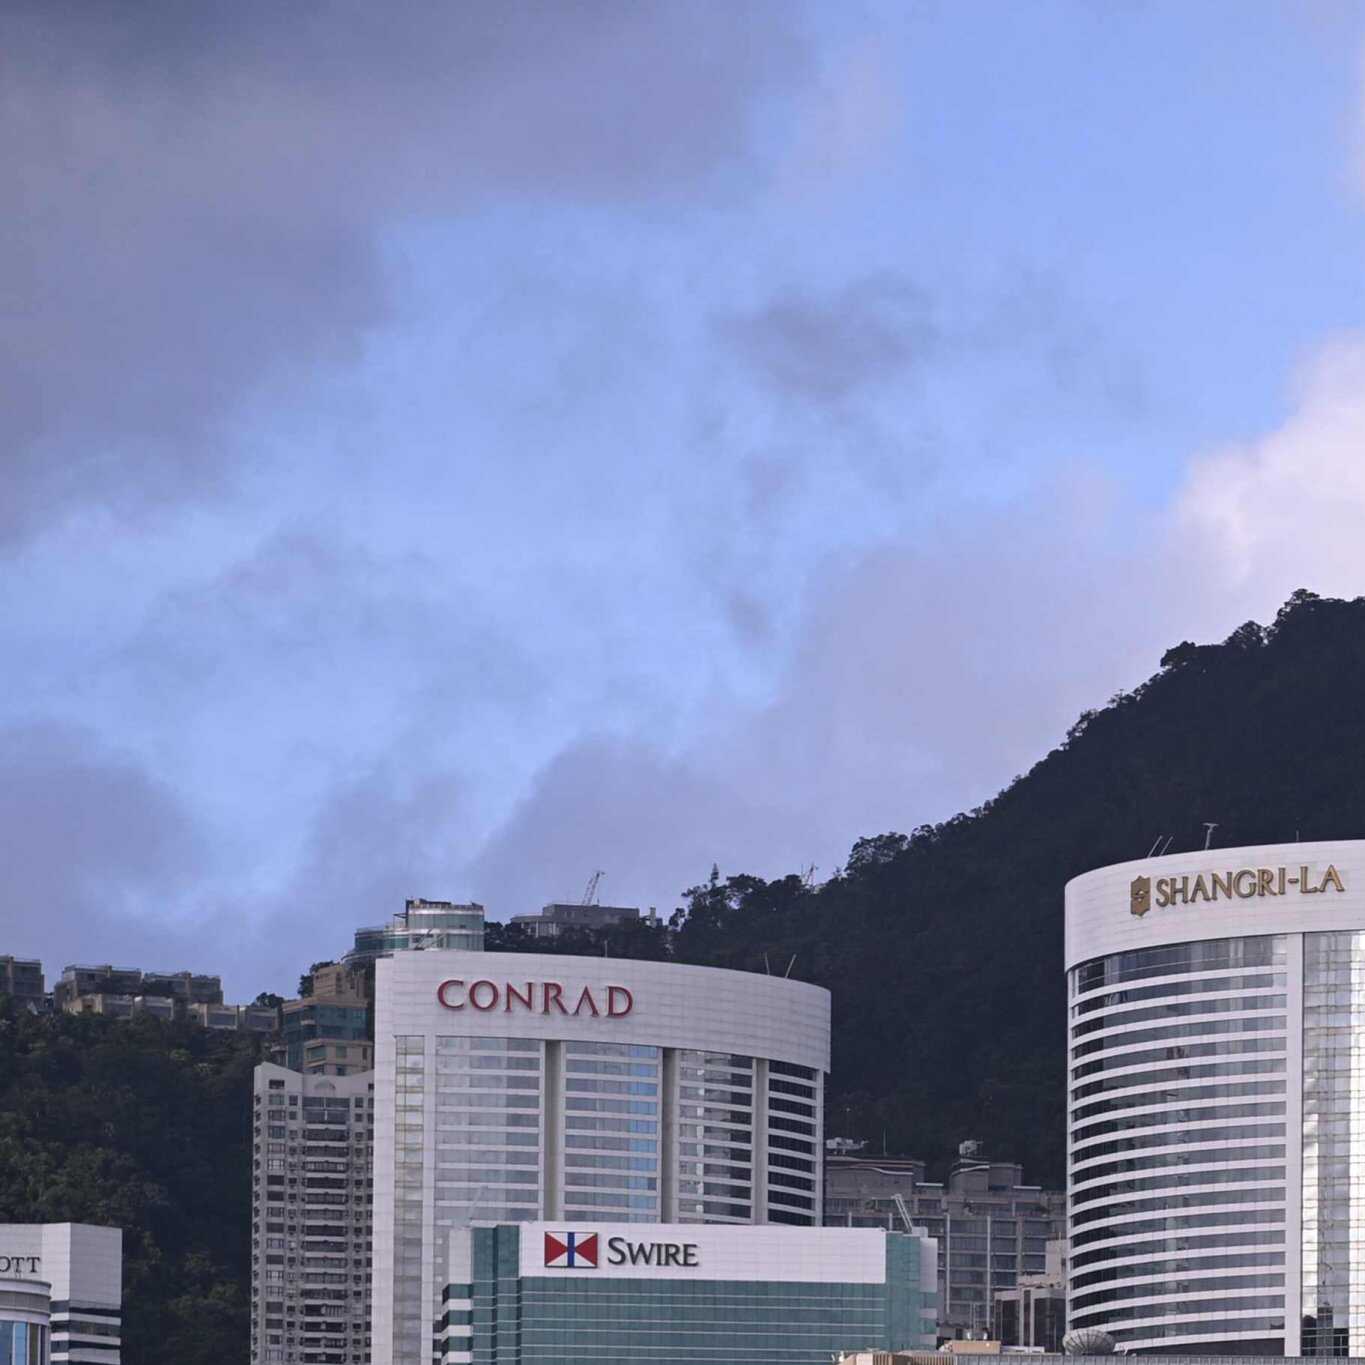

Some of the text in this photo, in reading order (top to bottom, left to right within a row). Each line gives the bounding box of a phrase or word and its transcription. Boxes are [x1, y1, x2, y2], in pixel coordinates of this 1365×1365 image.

[1155, 864, 1345, 907] SHANGRI-LA
[436, 979, 634, 1018] CONRAD
[607, 1236, 699, 1267] SWIRE
